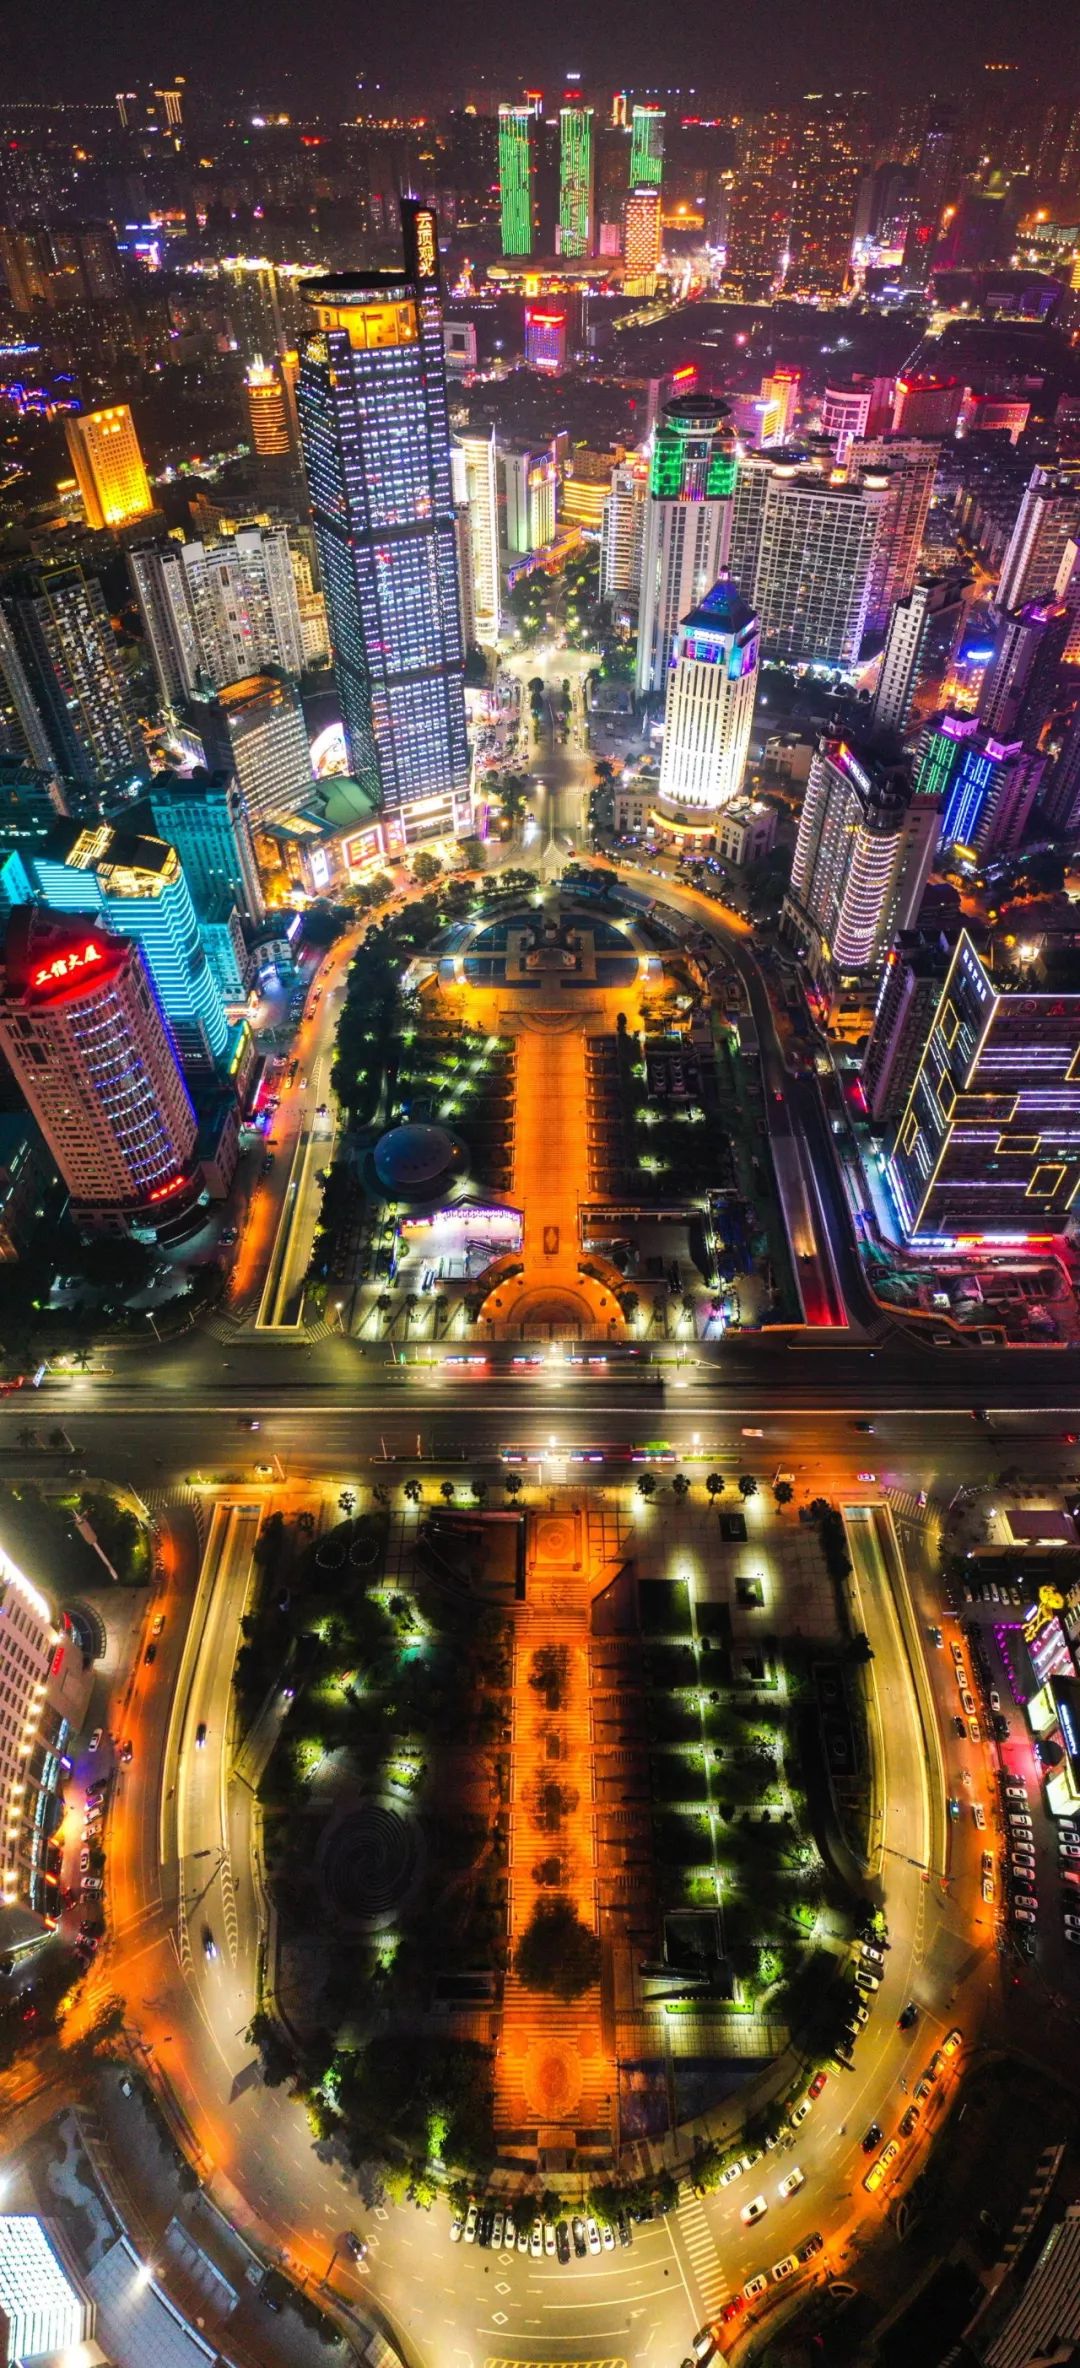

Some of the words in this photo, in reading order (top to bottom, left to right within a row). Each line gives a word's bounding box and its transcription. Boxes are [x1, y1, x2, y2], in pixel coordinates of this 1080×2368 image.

[417, 213, 434, 276] 云顶观光
[36, 945, 101, 985] 工信大厦
